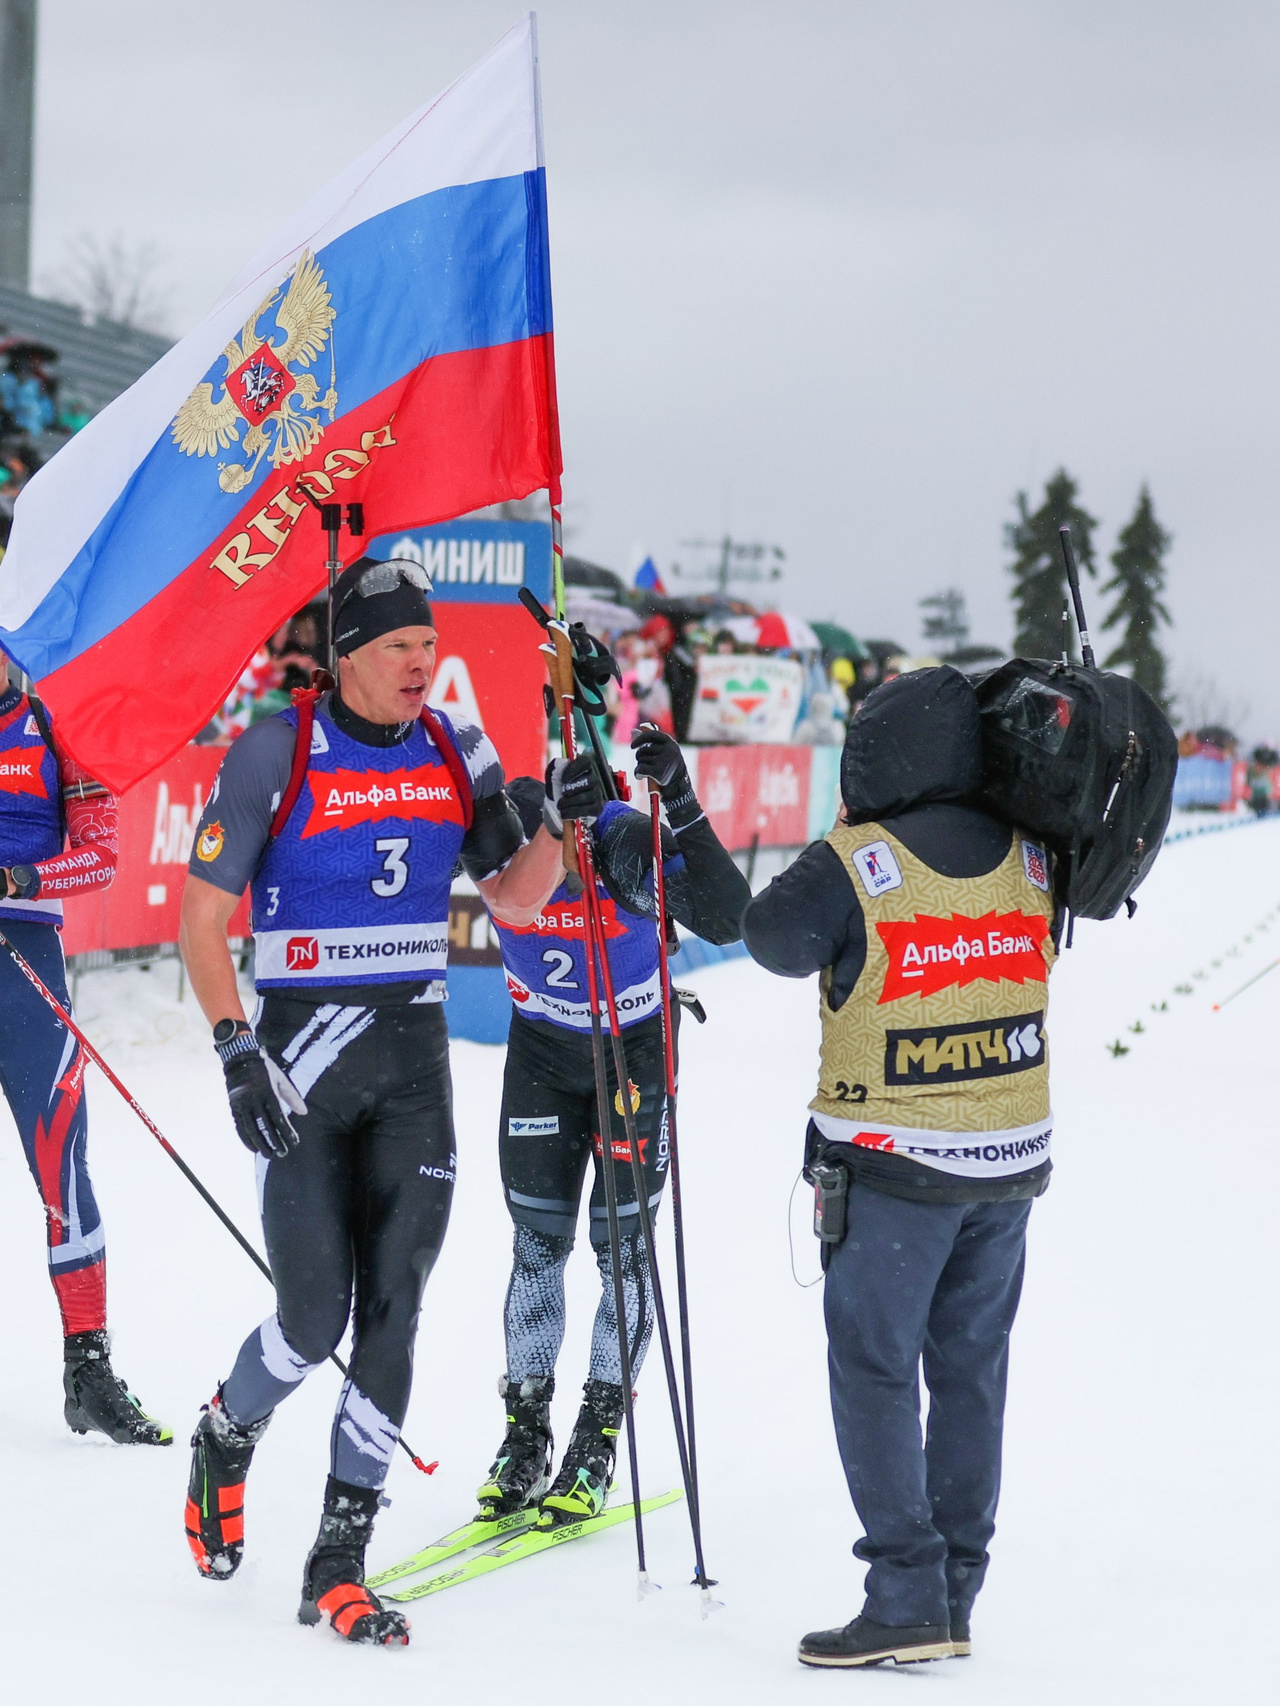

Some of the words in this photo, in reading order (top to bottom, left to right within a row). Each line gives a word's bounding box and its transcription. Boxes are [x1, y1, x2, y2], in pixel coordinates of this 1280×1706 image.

[389, 536, 525, 585] ФИНИШ
[324, 786, 397, 808] Альфа
[402, 782, 453, 803] Банк
[36, 850, 102, 876] #КОМАНДА
[371, 836, 410, 897] 3
[40, 867, 116, 891] ГУБЕРНАТОРА
[266, 886, 280, 916] 3
[561, 912, 609, 928] Бак
[324, 940, 449, 960] ТЕХНОНИКОЛЬ
[902, 936, 984, 968] Альфа
[988, 931, 1035, 957] Банк
[10, 951, 58, 1010] MOAX
[542, 949, 579, 989] 2
[54, 997, 71, 1029] MAX
[896, 1028, 1009, 1075] МАТЧ
[130, 1098, 165, 1141] MOAX
[528, 1121, 558, 1131] Parker
[496, 1513, 526, 1532] FISCHER
[551, 1524, 584, 1543] FISCHER
